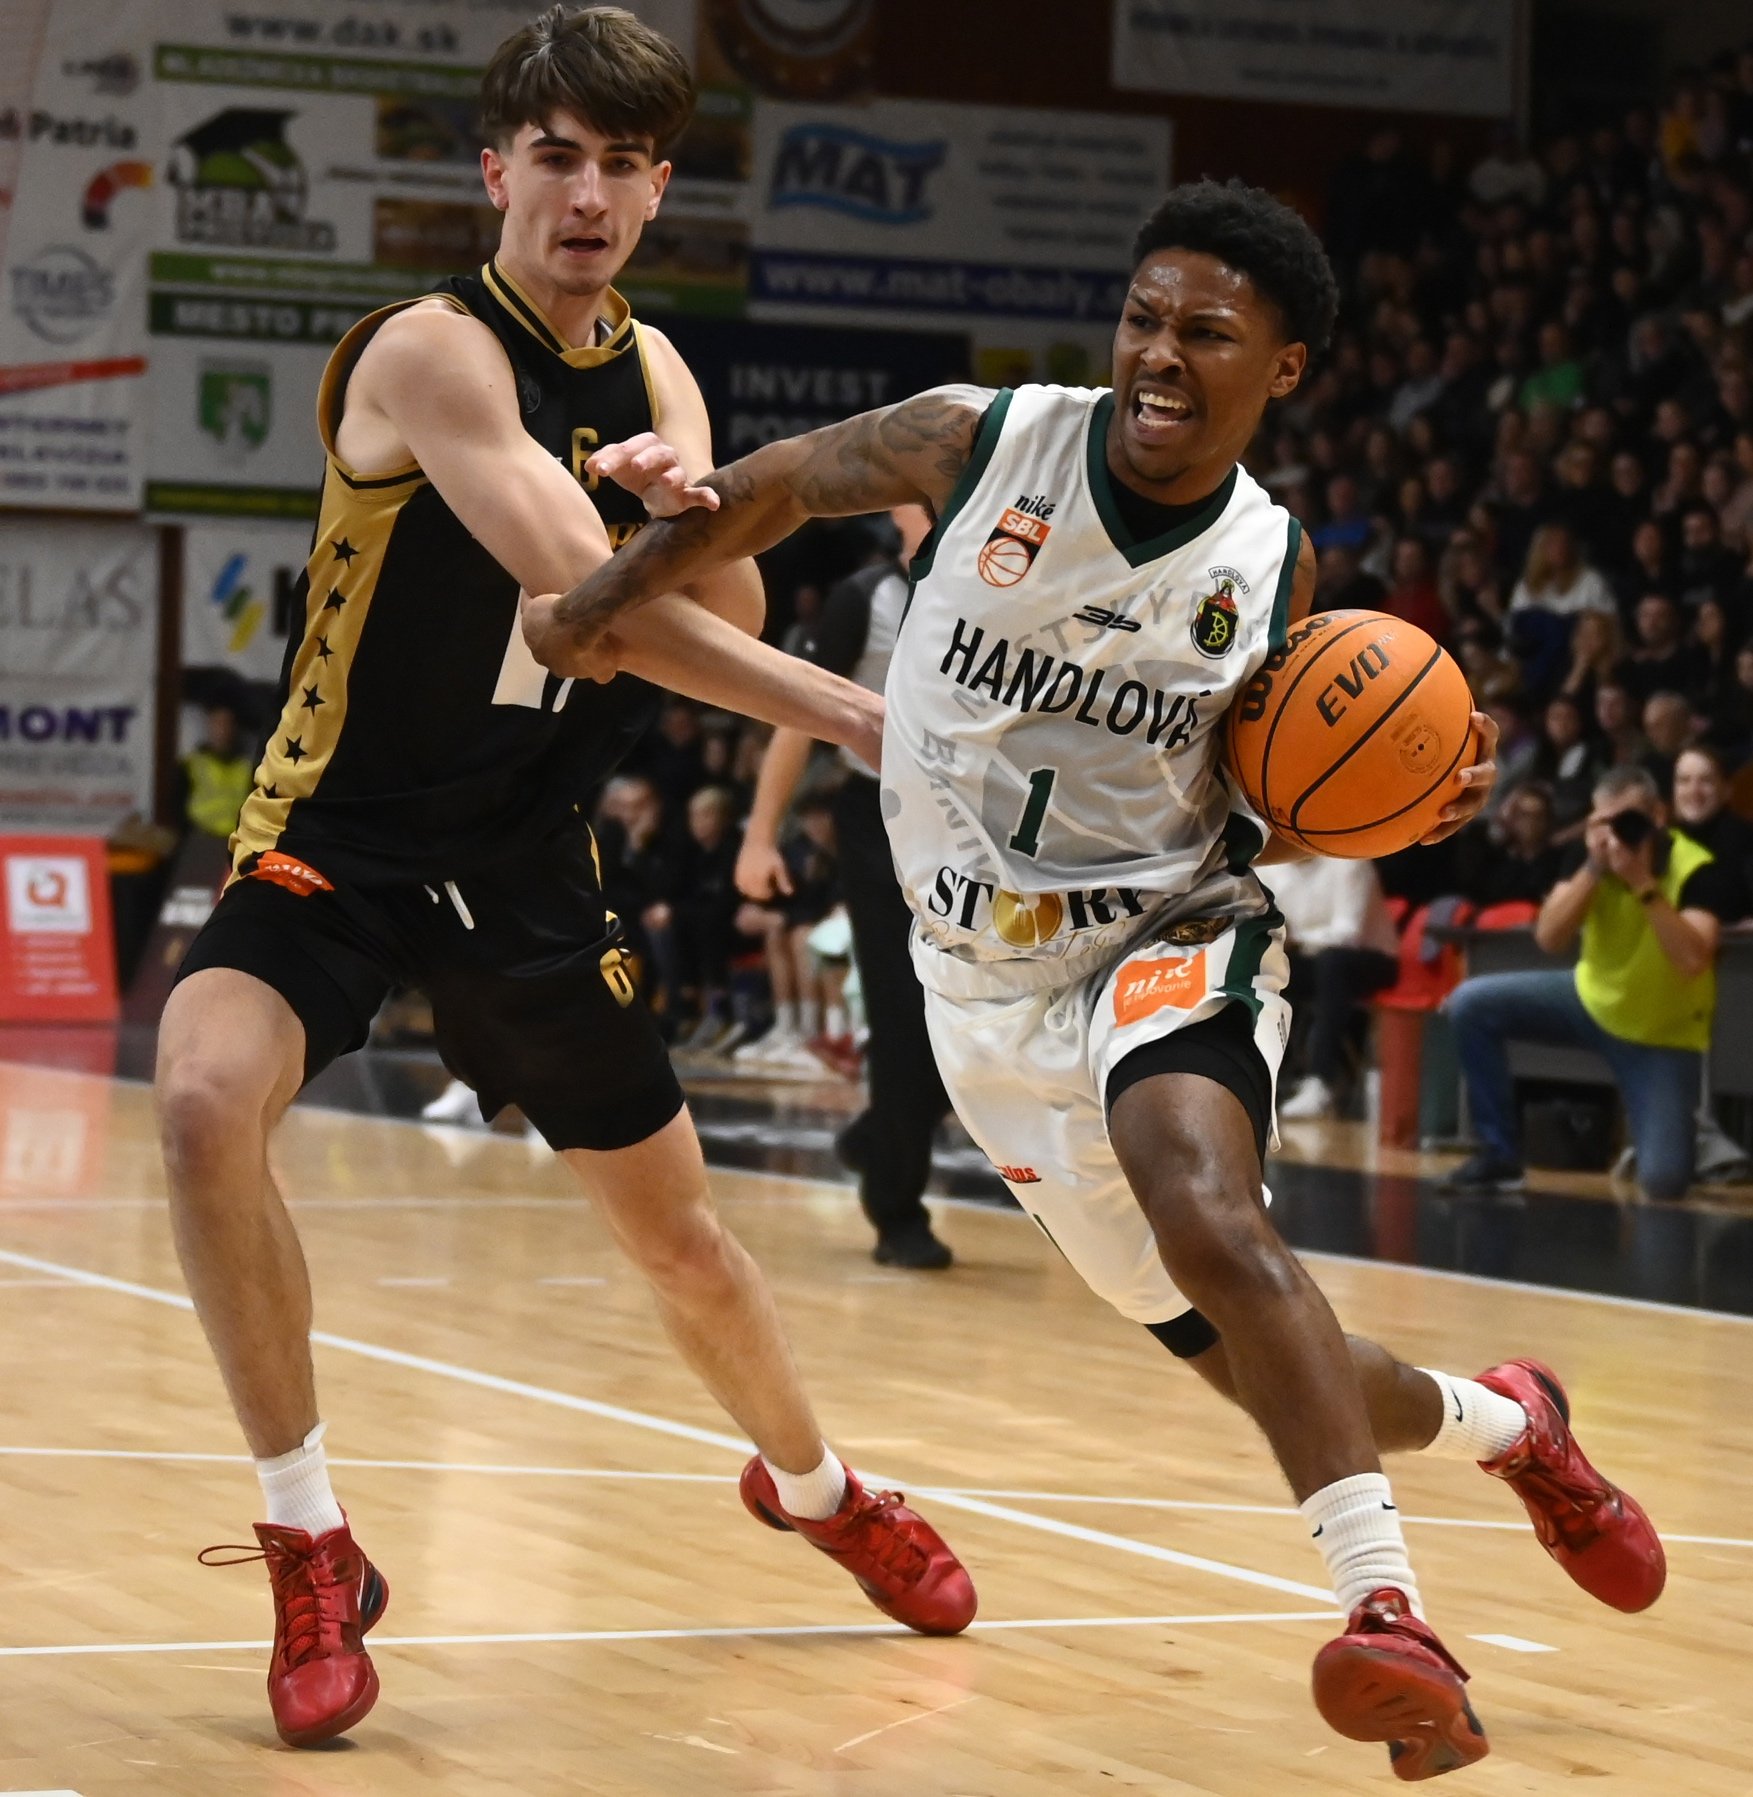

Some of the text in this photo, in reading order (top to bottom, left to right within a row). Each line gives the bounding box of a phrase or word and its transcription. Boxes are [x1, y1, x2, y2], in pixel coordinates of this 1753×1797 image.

[773, 134, 940, 211] MAT
[762, 261, 1126, 317] www.mat-obaly.s
[730, 362, 889, 407] INVEST
[1001, 513, 1041, 542] SBL
[1014, 494, 1056, 521] niké
[938, 617, 1212, 749] HANDLOVÁ
[1316, 642, 1390, 728] EVO
[1009, 766, 1057, 861] 1
